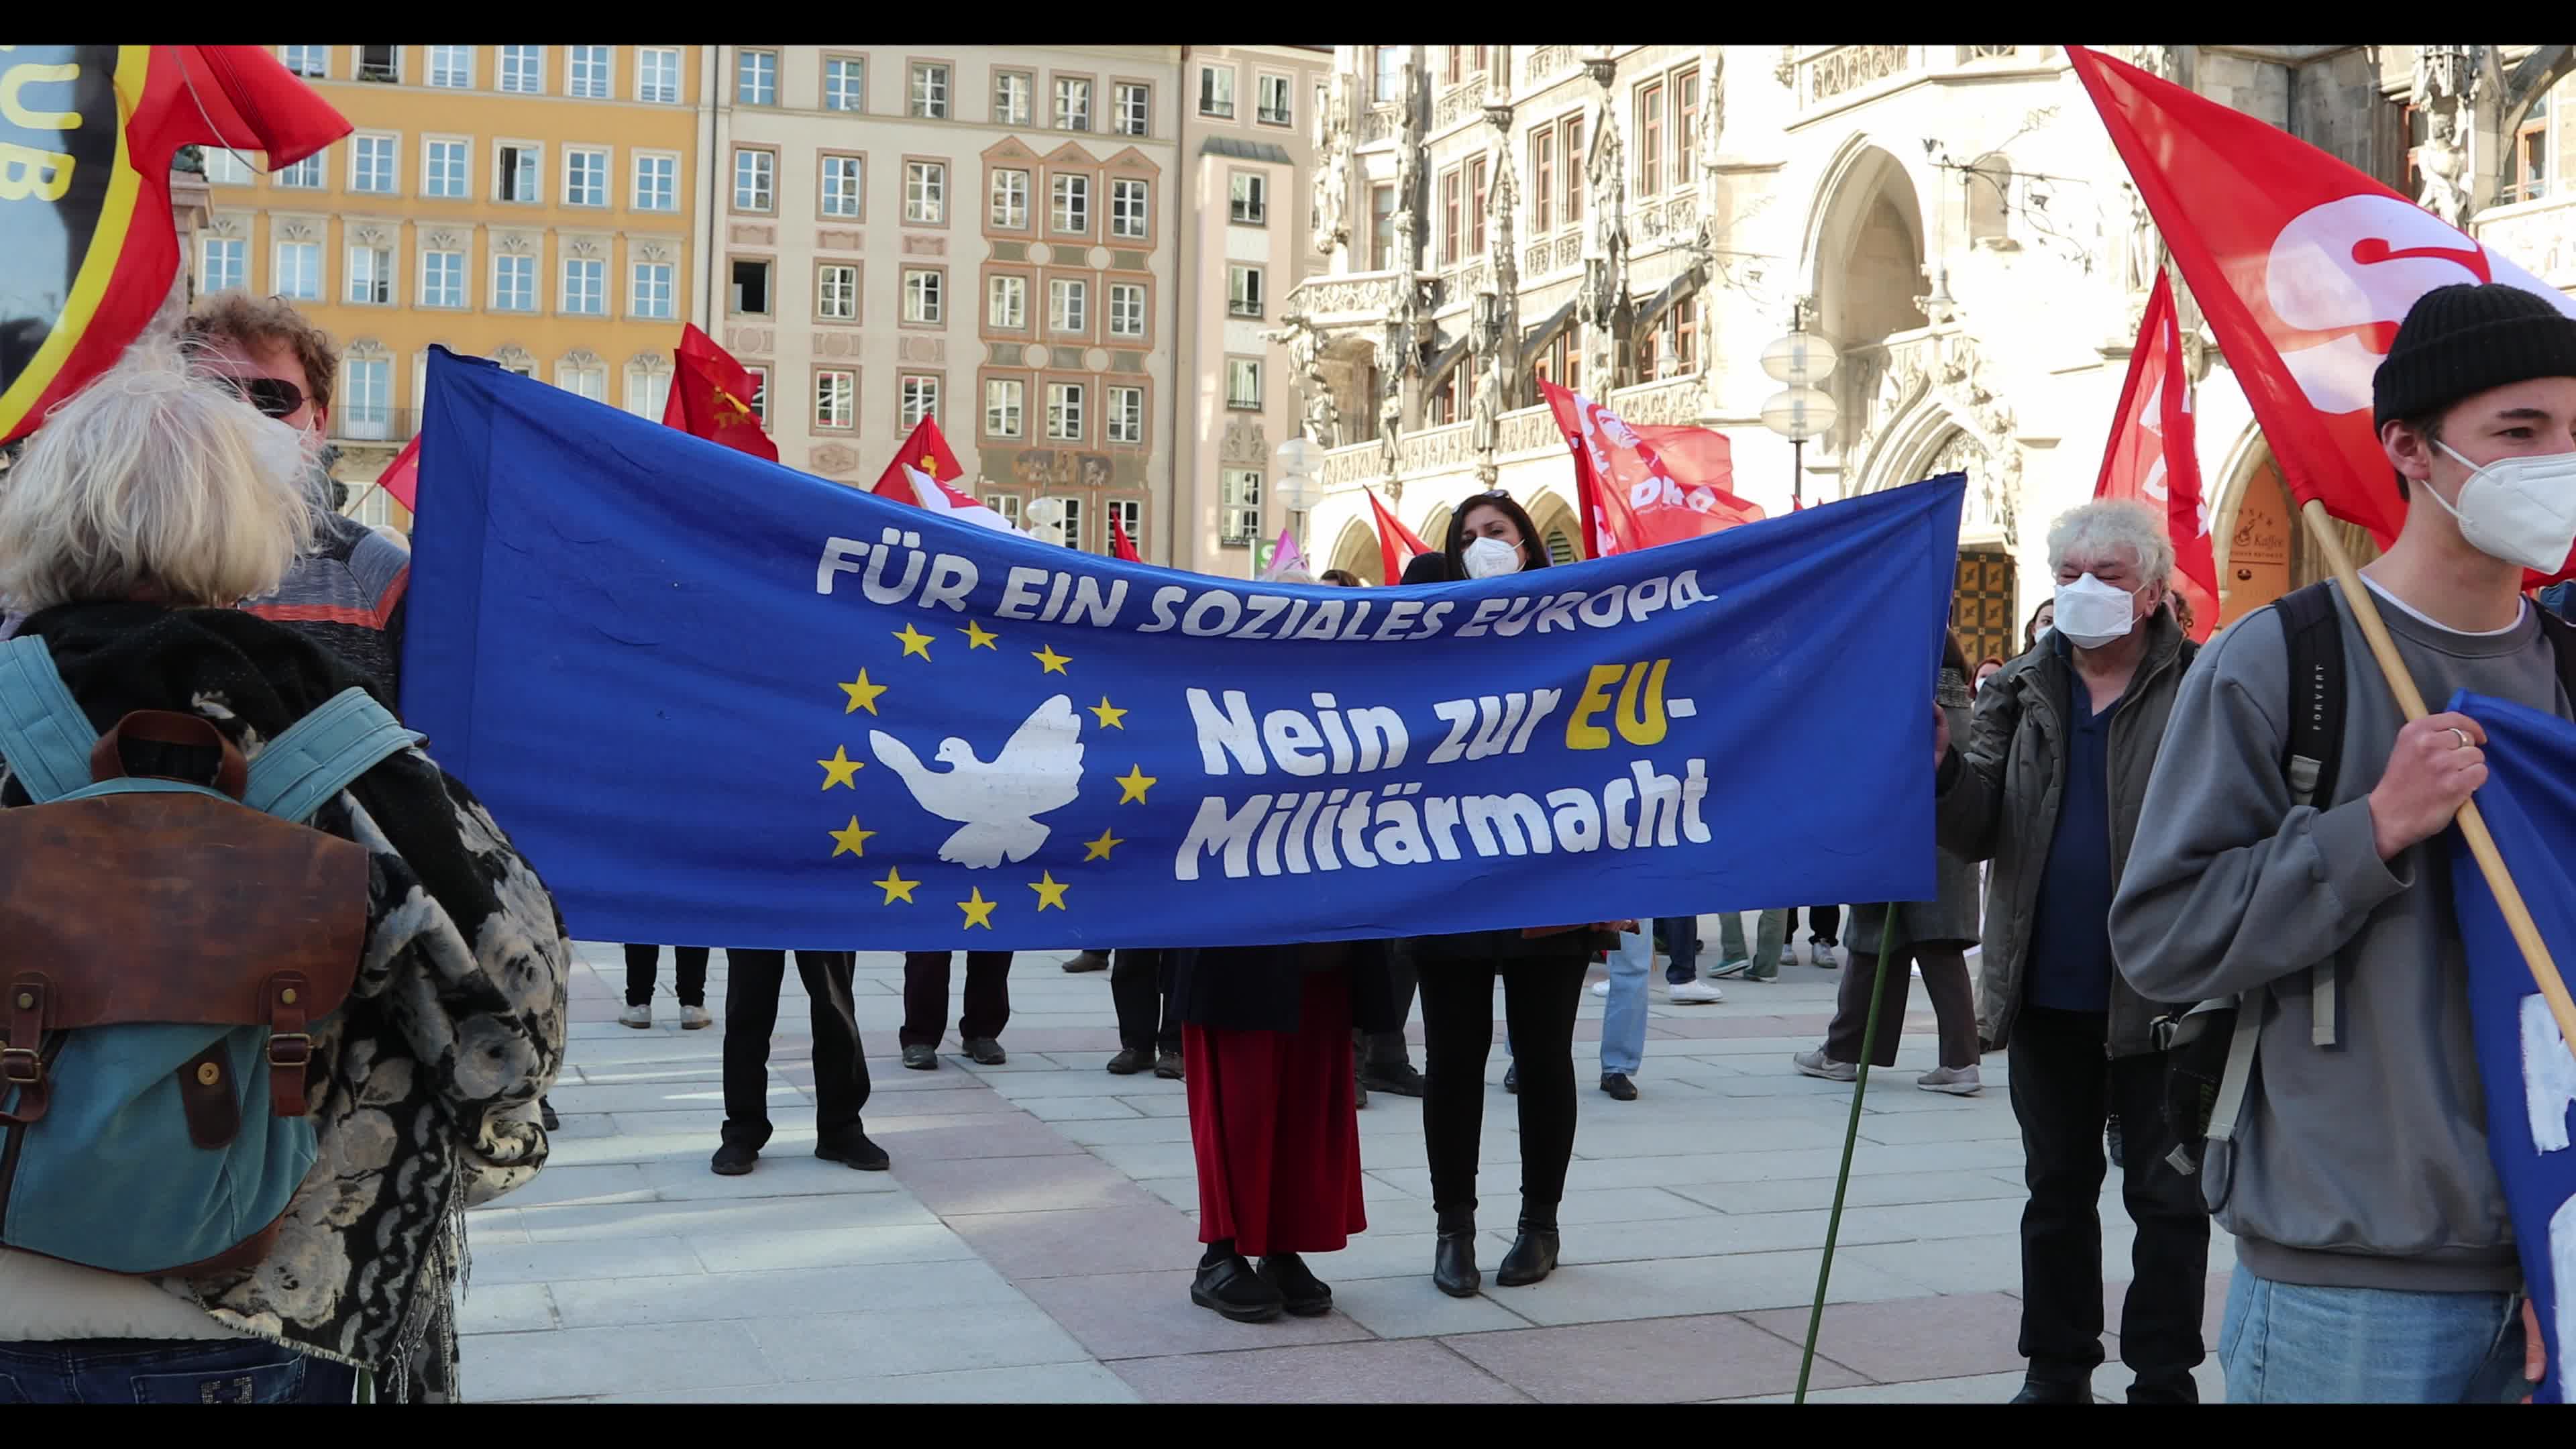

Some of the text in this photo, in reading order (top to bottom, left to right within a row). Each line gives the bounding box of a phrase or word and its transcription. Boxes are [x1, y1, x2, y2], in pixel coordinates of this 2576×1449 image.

[0, 45, 83, 201] UB
[816, 527, 1719, 641] FÜR EIN SOZIALES EUROPA
[1185, 659, 1698, 776] Nein zur EU-
[2312, 664, 2324, 731] FORVERT
[1175, 759, 1712, 881] Militärmacht
